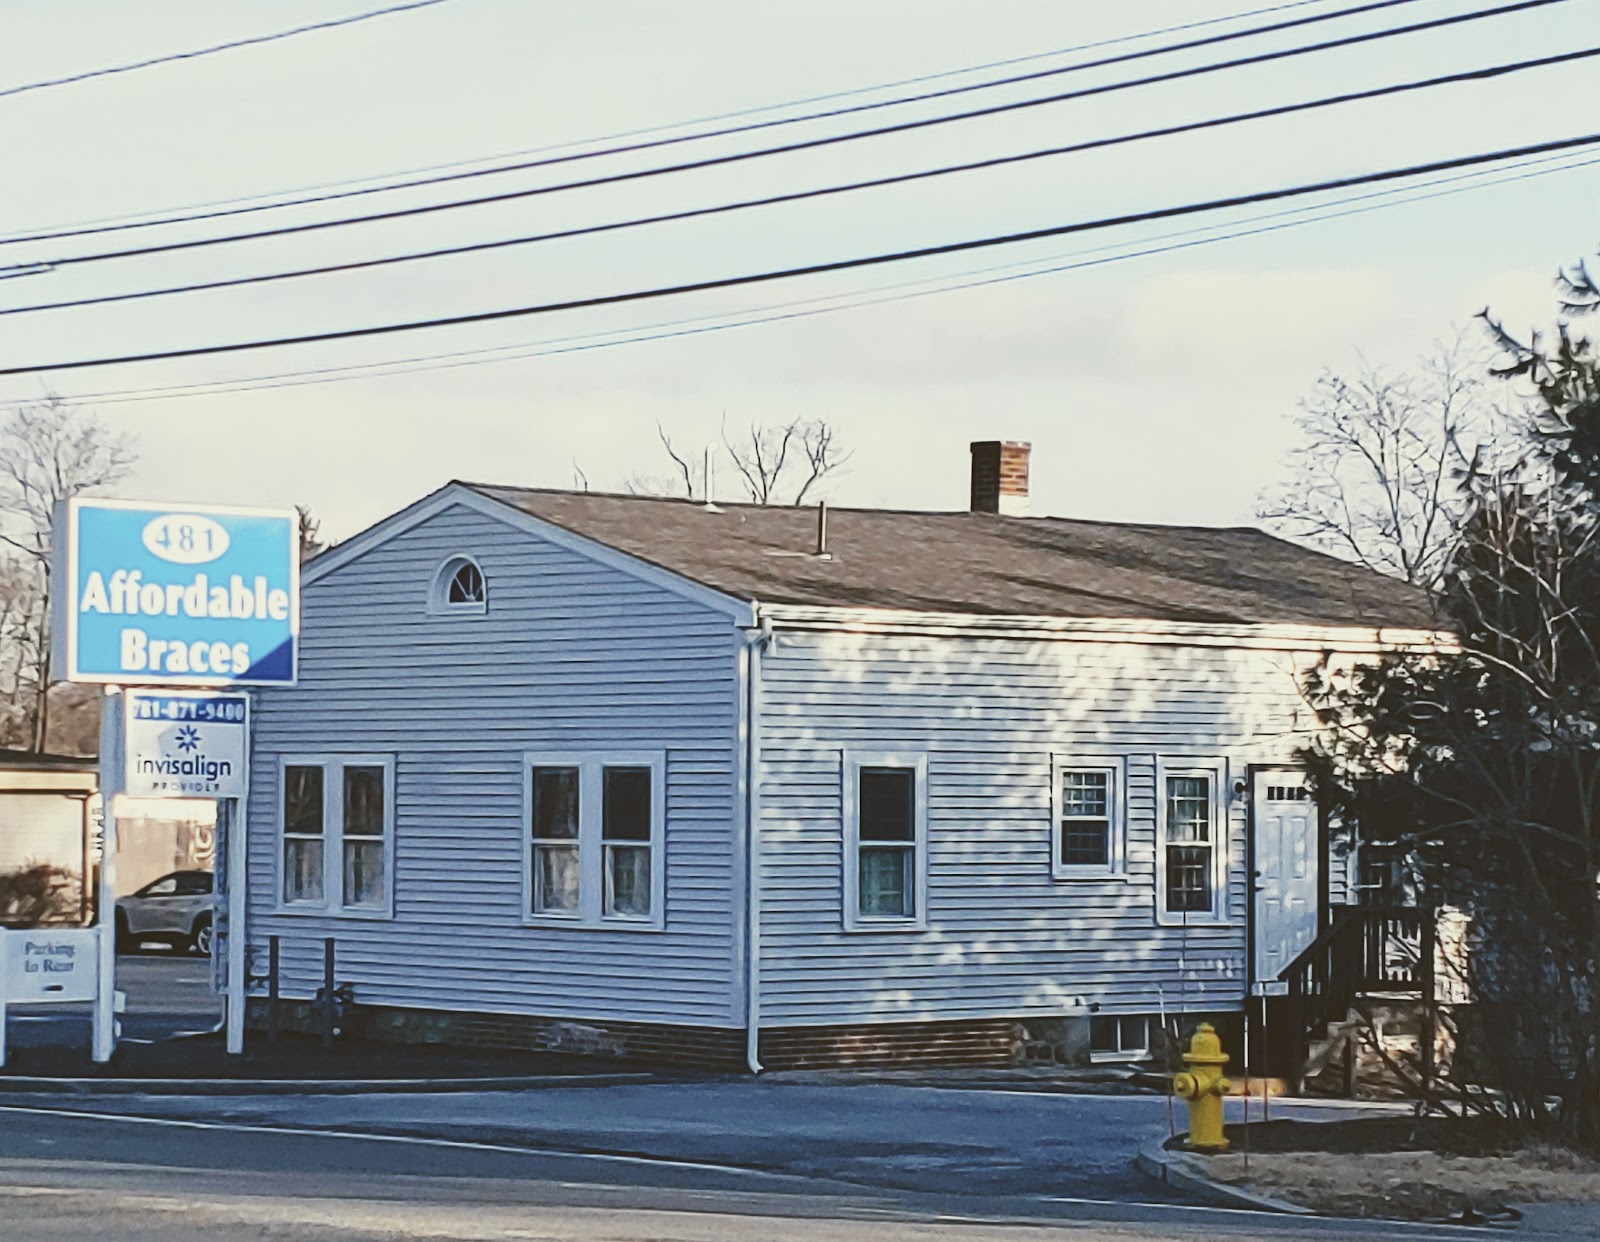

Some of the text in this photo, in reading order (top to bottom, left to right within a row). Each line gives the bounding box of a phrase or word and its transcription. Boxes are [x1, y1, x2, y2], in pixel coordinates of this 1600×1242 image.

[155, 523, 215, 553] 481
[80, 568, 289, 621] Affordable
[120, 628, 250, 675] Braces
[136, 752, 232, 782] invisalign
